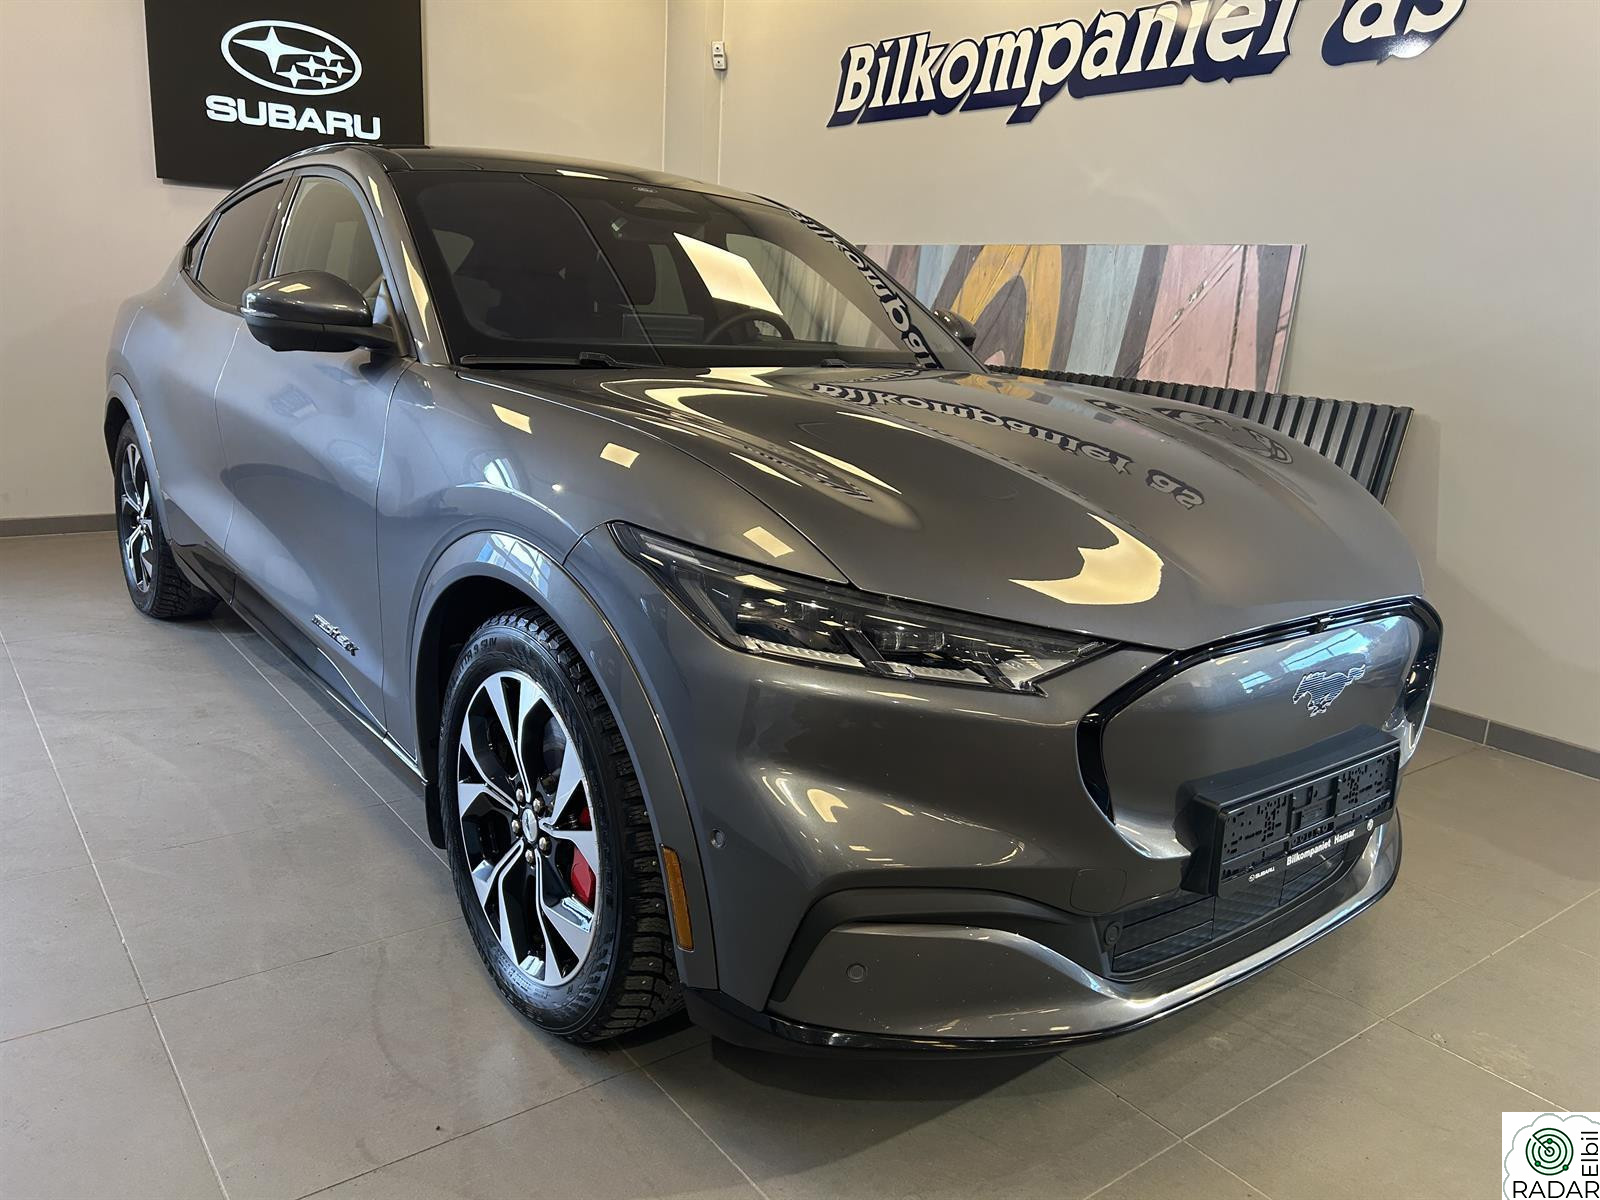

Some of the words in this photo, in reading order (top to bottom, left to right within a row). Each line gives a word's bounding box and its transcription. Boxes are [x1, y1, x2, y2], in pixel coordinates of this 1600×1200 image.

[204, 94, 381, 141] SUBARU
[480, 637, 498, 652] SUV
[1286, 838, 1331, 867] Bilkompaniet
[1334, 829, 1356, 845] Hamar
